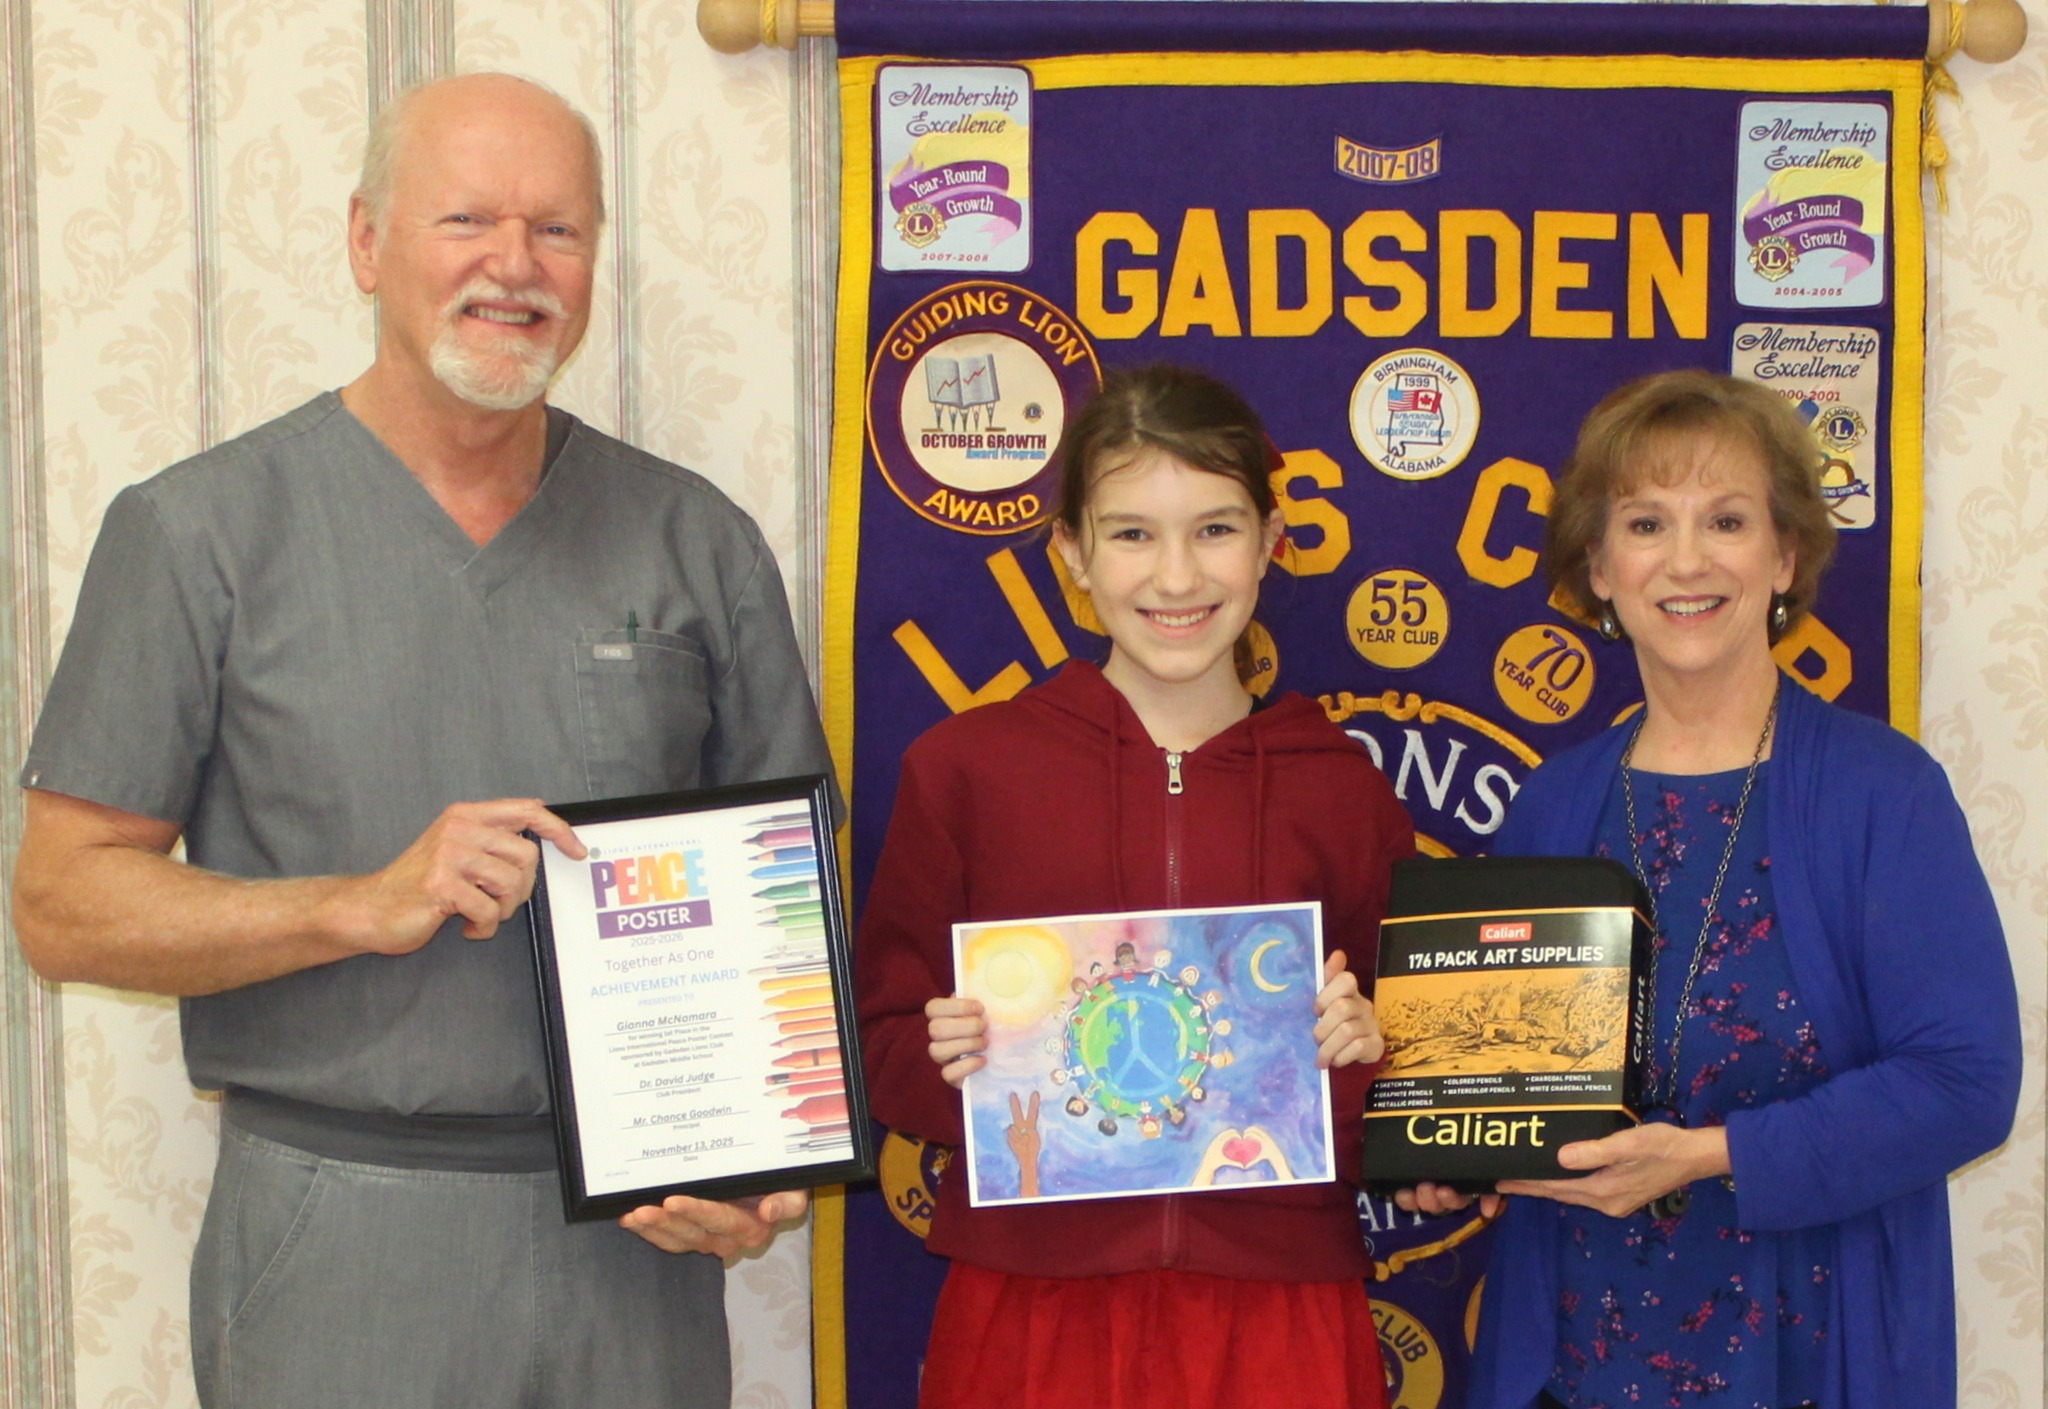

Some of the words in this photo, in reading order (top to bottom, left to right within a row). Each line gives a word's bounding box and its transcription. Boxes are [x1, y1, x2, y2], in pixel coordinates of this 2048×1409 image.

[888, 83, 1018, 111] Membership
[906, 111, 1006, 136] Excellence
[1749, 118, 1876, 147] Membership
[1344, 144, 1435, 180] 2007-08
[1764, 145, 1864, 171] Excellence
[946, 195, 994, 216] Growth
[914, 216, 928, 233] L
[1799, 231, 1847, 250] Growth
[921, 253, 989, 262] 2007-2008
[1766, 248, 1781, 266] L
[1076, 207, 1710, 340] GADSDEN
[1775, 287, 1843, 297] 2004-2005
[891, 290, 1010, 361] GUIDING
[1018, 300, 1086, 366] LION
[1736, 326, 1877, 359] Membership
[1374, 357, 1458, 384] BIRMINGHAM
[1753, 352, 1860, 379] Excellence
[1404, 377, 1430, 388] 1999
[1835, 420, 1849, 438] L
[921, 434, 983, 448] OCTOBER
[987, 434, 1047, 449] GROWTH
[965, 448, 998, 459] Award
[1001, 449, 1046, 460] Program
[1380, 455, 1446, 473] ALABAMA
[924, 489, 1040, 526] AWARD
[1370, 578, 1428, 627] 55
[1356, 629, 1396, 643] YEAR
[1403, 630, 1439, 645] CLUB
[1526, 628, 1585, 692] 70
[1500, 658, 1535, 691] YEAR
[1536, 688, 1570, 718] CLUB
[590, 849, 708, 909] PEACE
[617, 907, 692, 932] POSTER
[630, 932, 684, 947] 2025-2026
[1485, 926, 1526, 940] Caliart
[605, 953, 664, 973] Together
[668, 952, 684, 964] As
[687, 949, 715, 962] One
[1408, 952, 1432, 969] 176
[1434, 950, 1478, 967] PACK
[1483, 948, 1517, 965] ART
[1521, 945, 1604, 964] SUPPLIES
[590, 974, 687, 998] ACHIEVEMENT
[690, 968, 740, 985] AWARD
[617, 1018, 655, 1031] Gianna
[658, 1011, 717, 1026] McNamara
[1633, 974, 1646, 1064] Caliart
[626, 1040, 667, 1050] International
[639, 1080, 653, 1089] Dr.
[655, 1075, 684, 1087] David
[686, 1071, 715, 1083] Judge
[1408, 1089, 1433, 1097] PENCILS
[1447, 1087, 1488, 1095] WATERCOLOR
[1377, 1100, 1407, 1108] METALLIC
[633, 1116, 648, 1126] Mr.
[650, 1112, 687, 1124] Chance
[689, 1105, 732, 1119] Goodwin
[1406, 1113, 1546, 1147] Caliart
[641, 1143, 692, 1157] November
[694, 1140, 708, 1151] 13,
[710, 1137, 734, 1148] 2025
